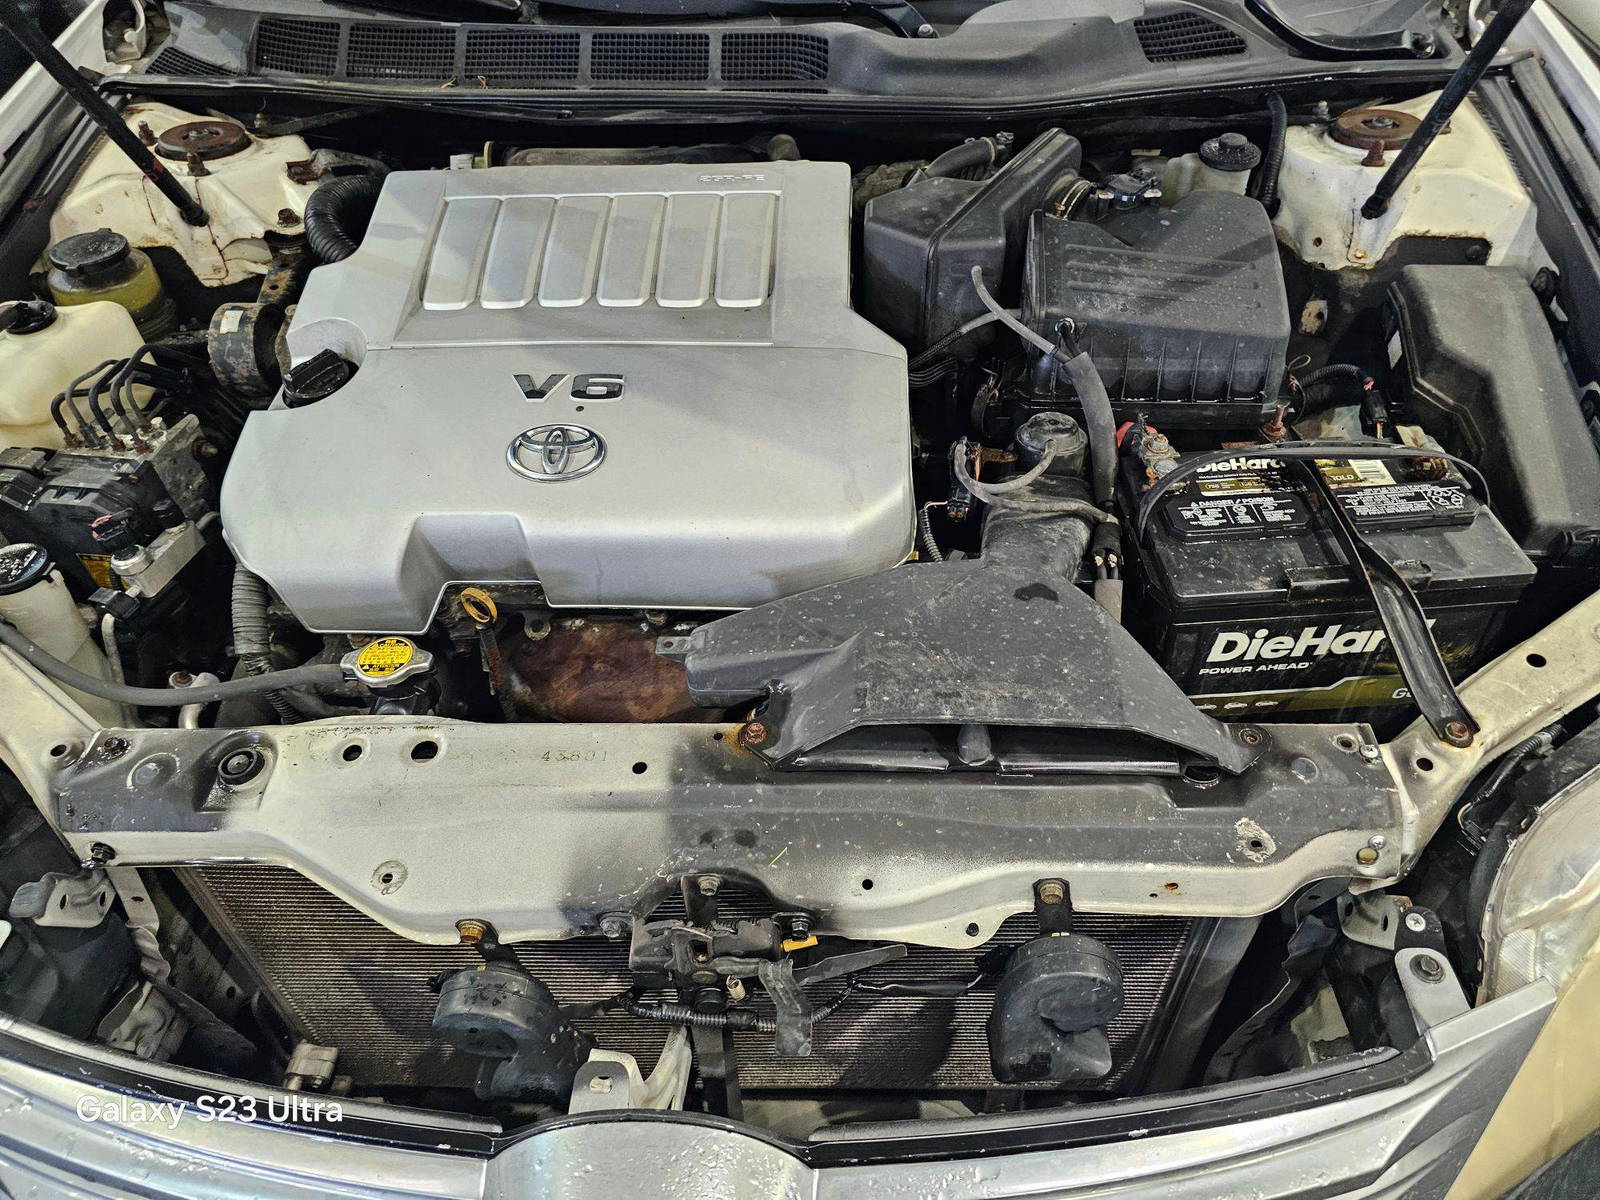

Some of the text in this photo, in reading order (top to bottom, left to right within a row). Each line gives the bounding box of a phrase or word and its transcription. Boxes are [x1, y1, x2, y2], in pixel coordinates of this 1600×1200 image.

[512, 374, 625, 402] V6
[1206, 618, 1436, 663] DieHar
[1199, 662, 1310, 675] POWER AHEAD
